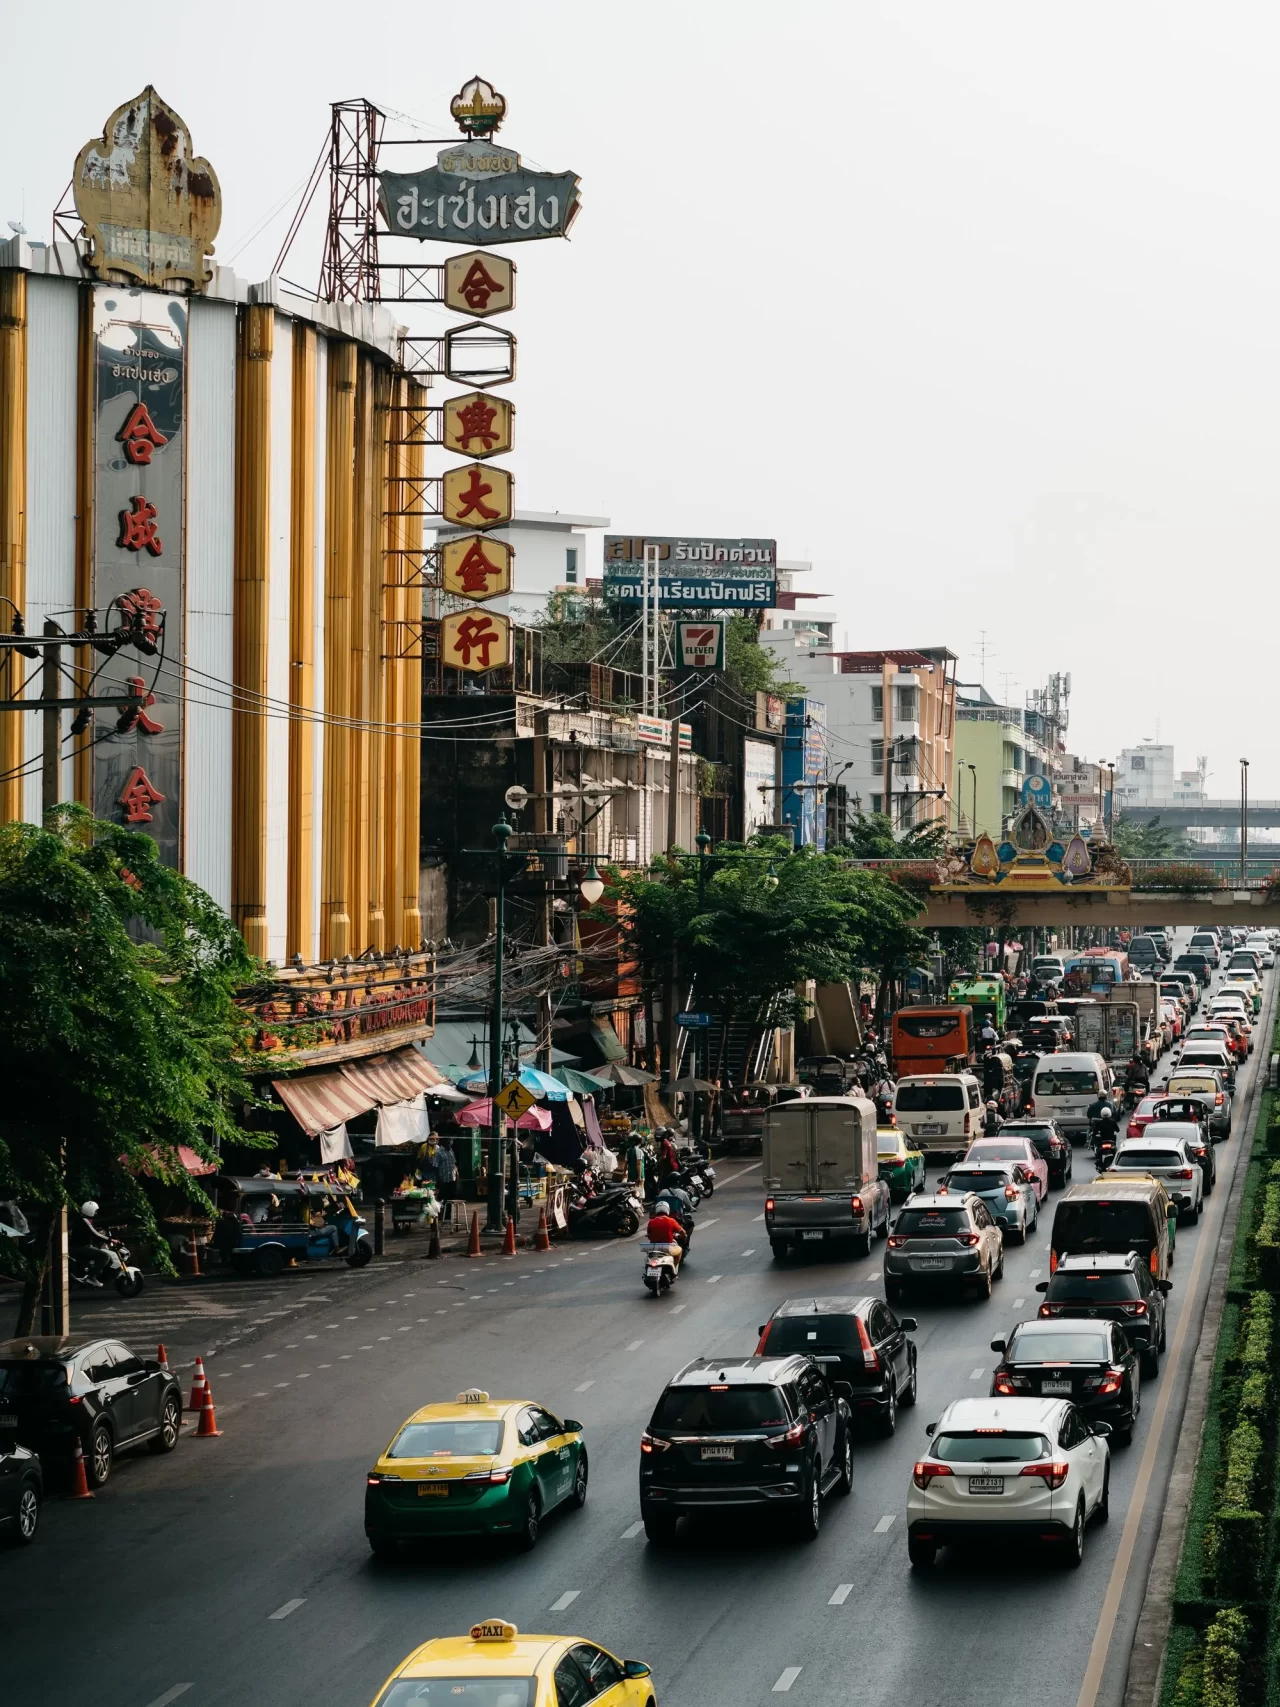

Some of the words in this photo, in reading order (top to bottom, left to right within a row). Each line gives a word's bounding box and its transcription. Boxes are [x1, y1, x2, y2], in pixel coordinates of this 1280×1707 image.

[443, 152, 514, 173] ห้างทอง
[396, 180, 559, 230] ฮะเซ่งเฮง
[685, 646, 714, 654] ELEVEN
[465, 1393, 480, 1402] TAXI
[482, 1626, 504, 1637] TAXI
